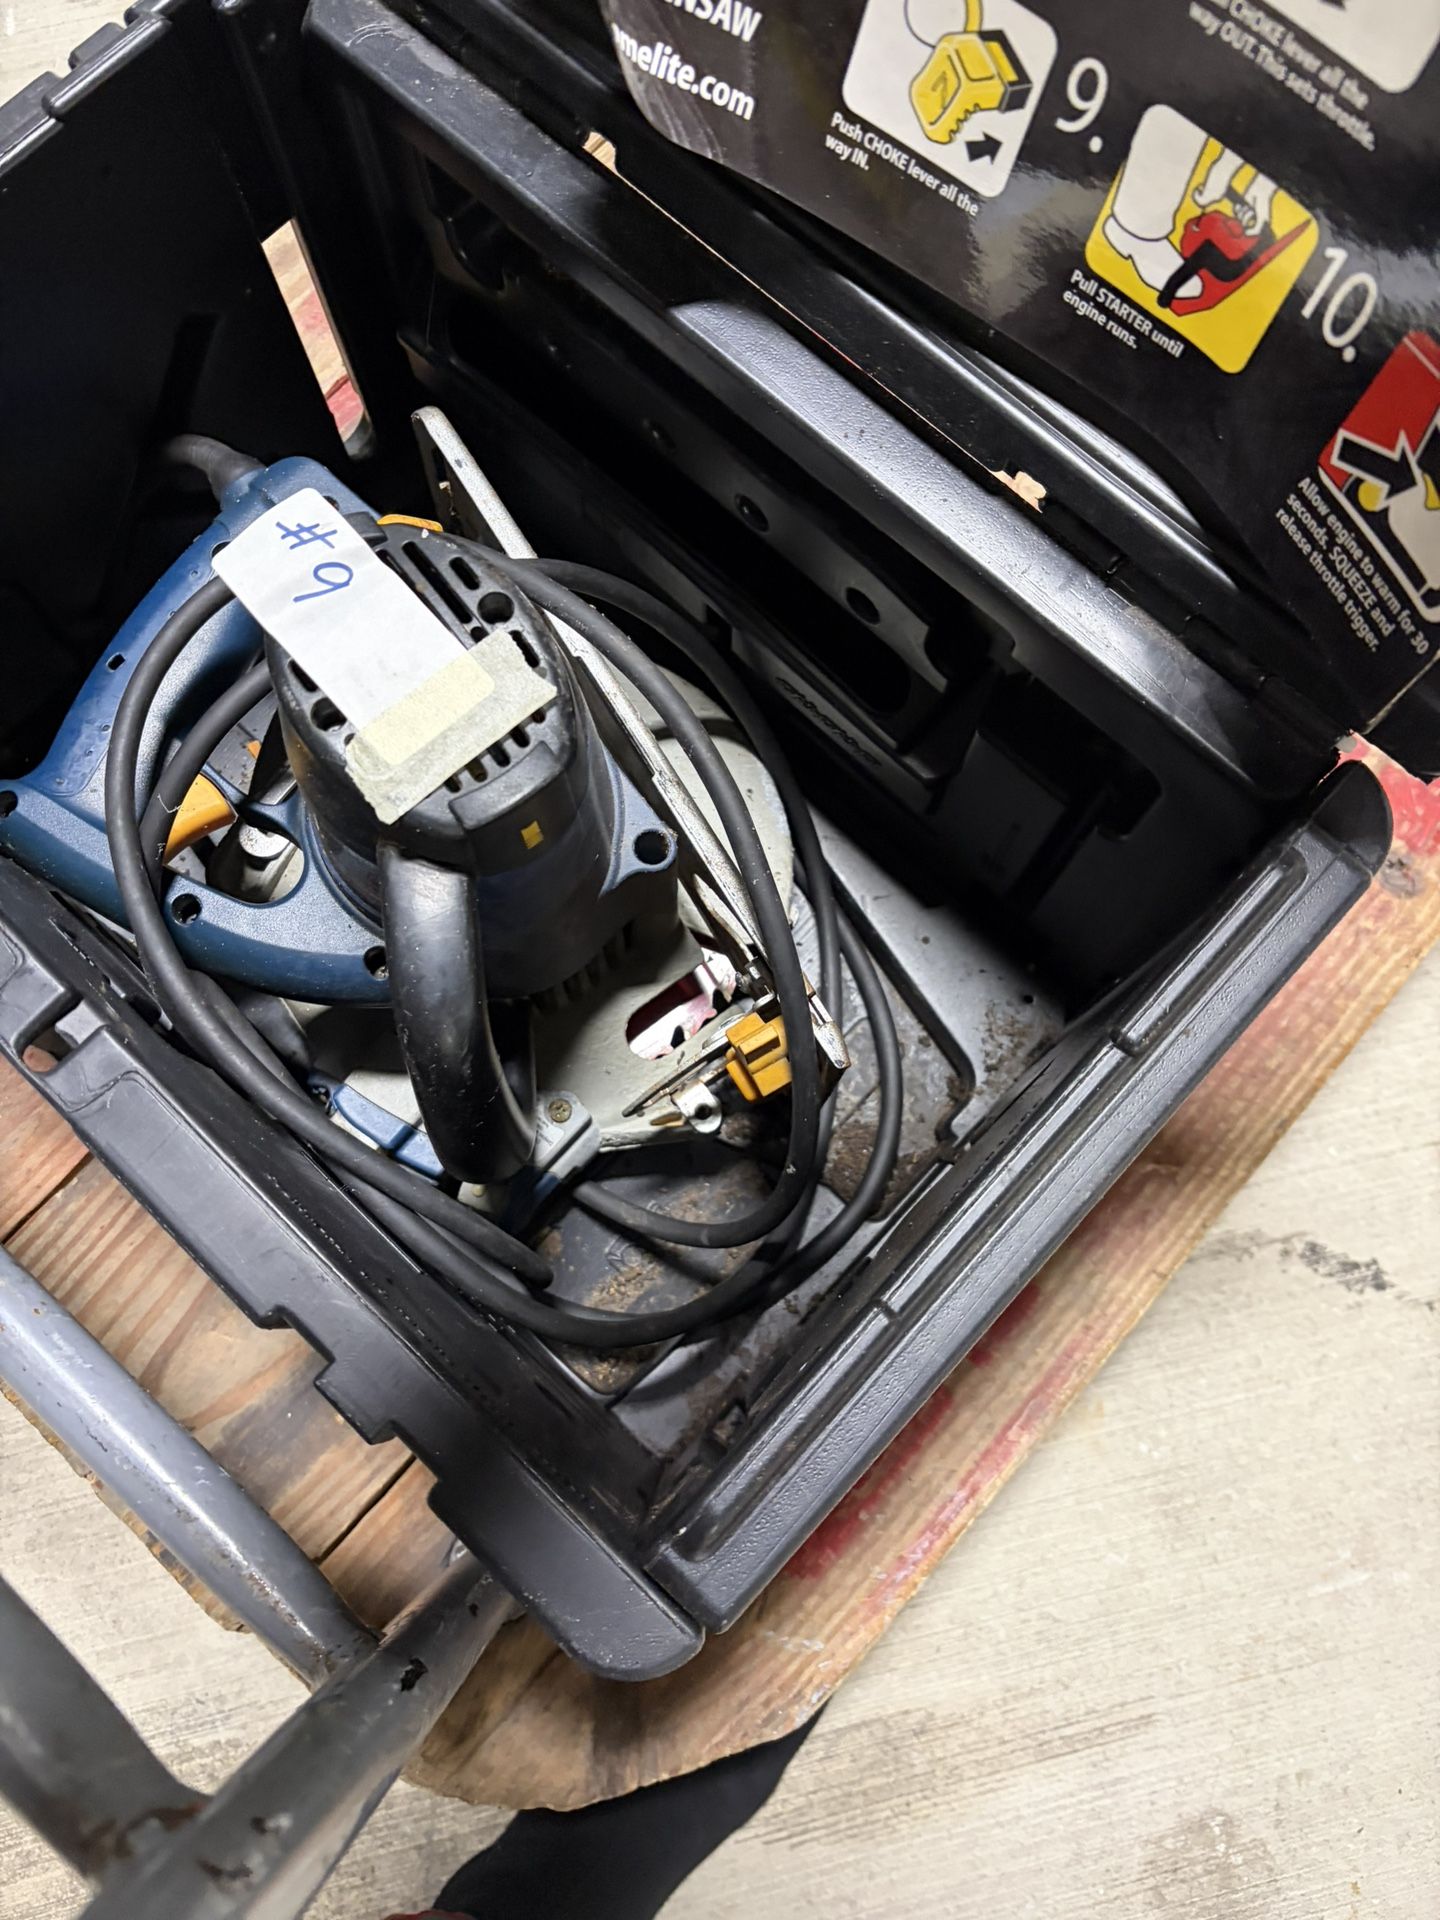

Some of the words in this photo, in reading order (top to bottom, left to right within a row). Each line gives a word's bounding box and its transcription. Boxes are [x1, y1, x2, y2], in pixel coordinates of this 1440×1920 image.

[1189, 2, 1222, 36] way
[825, 134, 852, 161] way
[852, 151, 870, 170] IN.
[1055, 57, 1108, 153] 9.
[831, 112, 864, 143] Push
[864, 133, 909, 171] CHOKE
[907, 159, 940, 191] lever
[938, 184, 957, 203] all
[956, 194, 979, 216] the
[1062, 290, 1107, 326] engine
[1105, 320, 1137, 349] runs.
[1070, 269, 1098, 296] Pull
[1095, 288, 1153, 336] STARTER
[1150, 330, 1184, 358] until
[1301, 247, 1378, 362] 10.
[276, 521, 338, 550] #
[1275, 508, 1313, 556] release
[1309, 550, 1348, 603] throttle
[1344, 600, 1381, 652] trigger.
[1286, 493, 1328, 550] seconds.
[1328, 546, 1377, 611] SQUEEZE
[1370, 606, 1396, 638] and
[1297, 477, 1330, 517] Allow
[1326, 514, 1363, 561] engine
[1360, 556, 1375, 576] to
[1371, 572, 1402, 614] warm
[1397, 609, 1415, 635] for
[1410, 631, 1430, 655] 30
